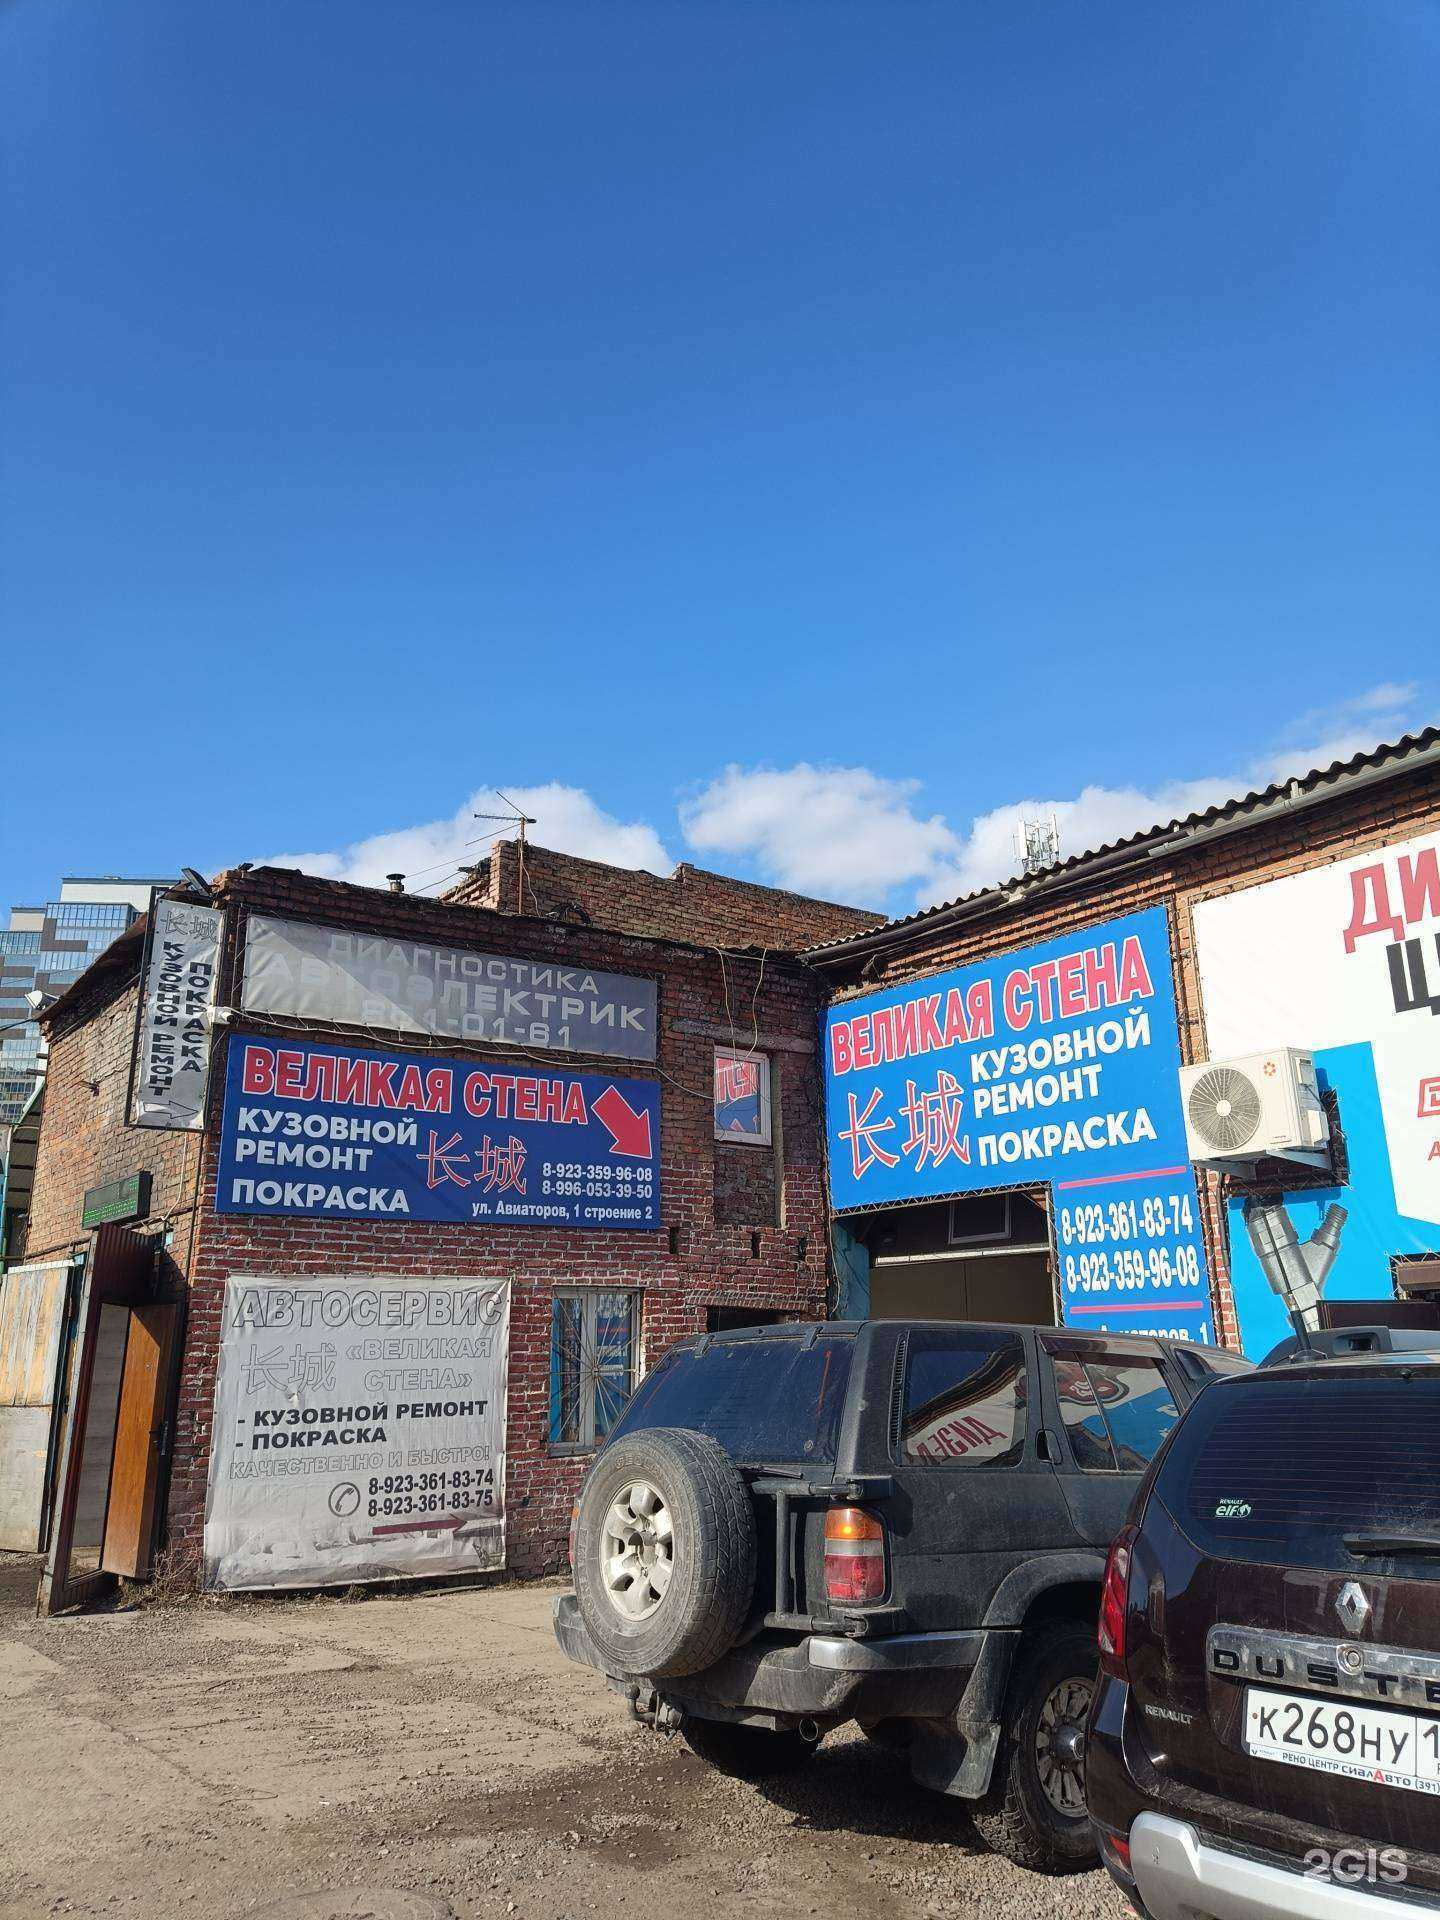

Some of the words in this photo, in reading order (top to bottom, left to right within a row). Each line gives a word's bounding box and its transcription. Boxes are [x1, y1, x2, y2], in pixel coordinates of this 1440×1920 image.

[160, 910, 218, 942] 长城
[328, 934, 600, 994] ДИАГНОСТИКА
[1386, 932, 1440, 1017] Ц
[154, 941, 183, 1027] КУЗОВНОЙ
[180, 962, 212, 1073] ПОКРАСКА
[831, 978, 994, 1076] ВЕЛИКАЯ
[1003, 935, 1155, 1031] СТЕНА
[970, 1006, 1151, 1083] КУЗОВНОЙ
[149, 1033, 175, 1096] РЕМОНТ
[242, 1045, 453, 1114] ВЕЛИКАЯ
[463, 1071, 588, 1125] СТЕНА
[973, 1063, 1102, 1119] РЕМОНТ
[238, 1107, 417, 1146] КУЗОВНОЙ
[838, 1070, 971, 1180] 长城
[978, 1107, 1158, 1166] ПОКРАСКА
[235, 1138, 373, 1172] РЕМОНТ
[416, 1130, 527, 1195] 长城
[542, 1163, 653, 1181] 8-923-359-96-08
[232, 1178, 411, 1213] ПОКРАСКА
[541, 1180, 653, 1198] 8-996-053-39-50
[472, 1202, 492, 1217] ул.
[496, 1200, 569, 1219] Авиаторов,
[574, 1204, 580, 1217] 1
[584, 1205, 641, 1221] строение
[645, 1206, 653, 1219] 2
[1061, 1194, 1194, 1245] 8-923-361-83-74
[1066, 1245, 1200, 1293] 8-923-359-96-08
[232, 1290, 502, 1328] АВТОСЕРВИС
[346, 1337, 493, 1360] «ВЕЛИКАЯ
[241, 1343, 337, 1395] 长城
[365, 1368, 472, 1392] СТЕНА»
[254, 1402, 388, 1426] КУЗОВНОЙ
[396, 1401, 488, 1419] РЕМОНТ
[252, 1427, 387, 1450] ПОКРАСКА
[230, 1453, 383, 1479] КАЧЕСТВЕННО
[389, 1452, 402, 1468] И
[408, 1446, 490, 1466] БЫСТРО!
[369, 1468, 494, 1495] 8-923-361-83-74
[368, 1489, 493, 1517] 8-923-361-83-75
[1216, 1505, 1239, 1516] elf
[1145, 1704, 1193, 1725] RENAULT
[1259, 1702, 1409, 1765] К268НУ
[1282, 1752, 1306, 1764] РЕНО
[1308, 1757, 1339, 1770] ЦЕНТР
